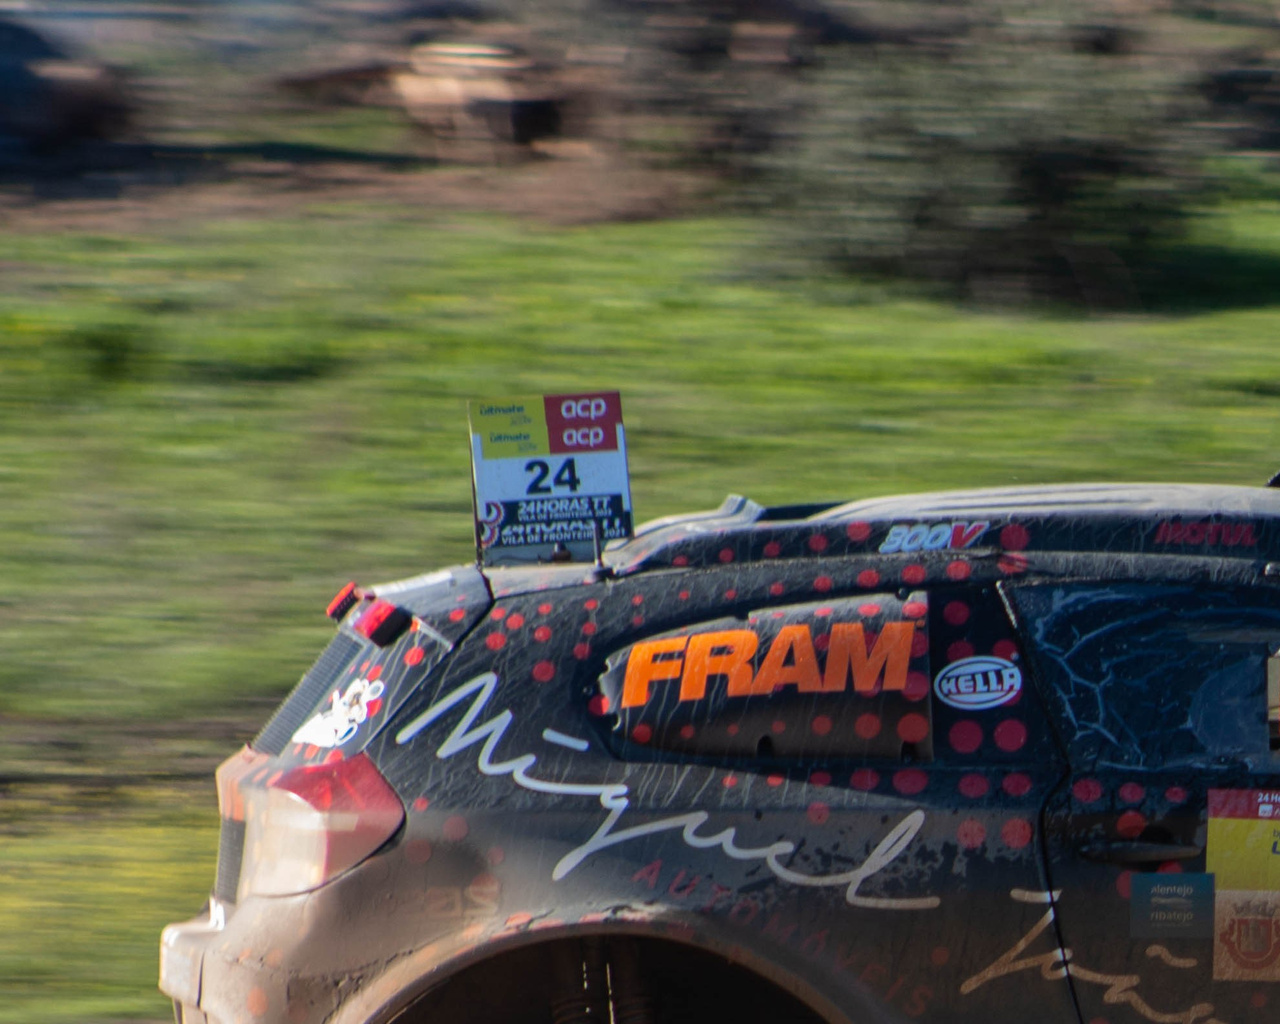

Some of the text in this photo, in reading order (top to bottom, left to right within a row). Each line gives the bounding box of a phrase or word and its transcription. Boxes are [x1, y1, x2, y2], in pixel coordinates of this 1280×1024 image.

[561, 397, 606, 420] acp
[563, 427, 604, 447] acp
[524, 457, 581, 495] 24
[501, 534, 525, 545] VILA
[528, 533, 541, 543] DE
[1153, 521, 1258, 546] MOTUL
[621, 621, 915, 708] FRAM
[941, 667, 1021, 694] HELLA
[1257, 792, 1269, 802] 24
